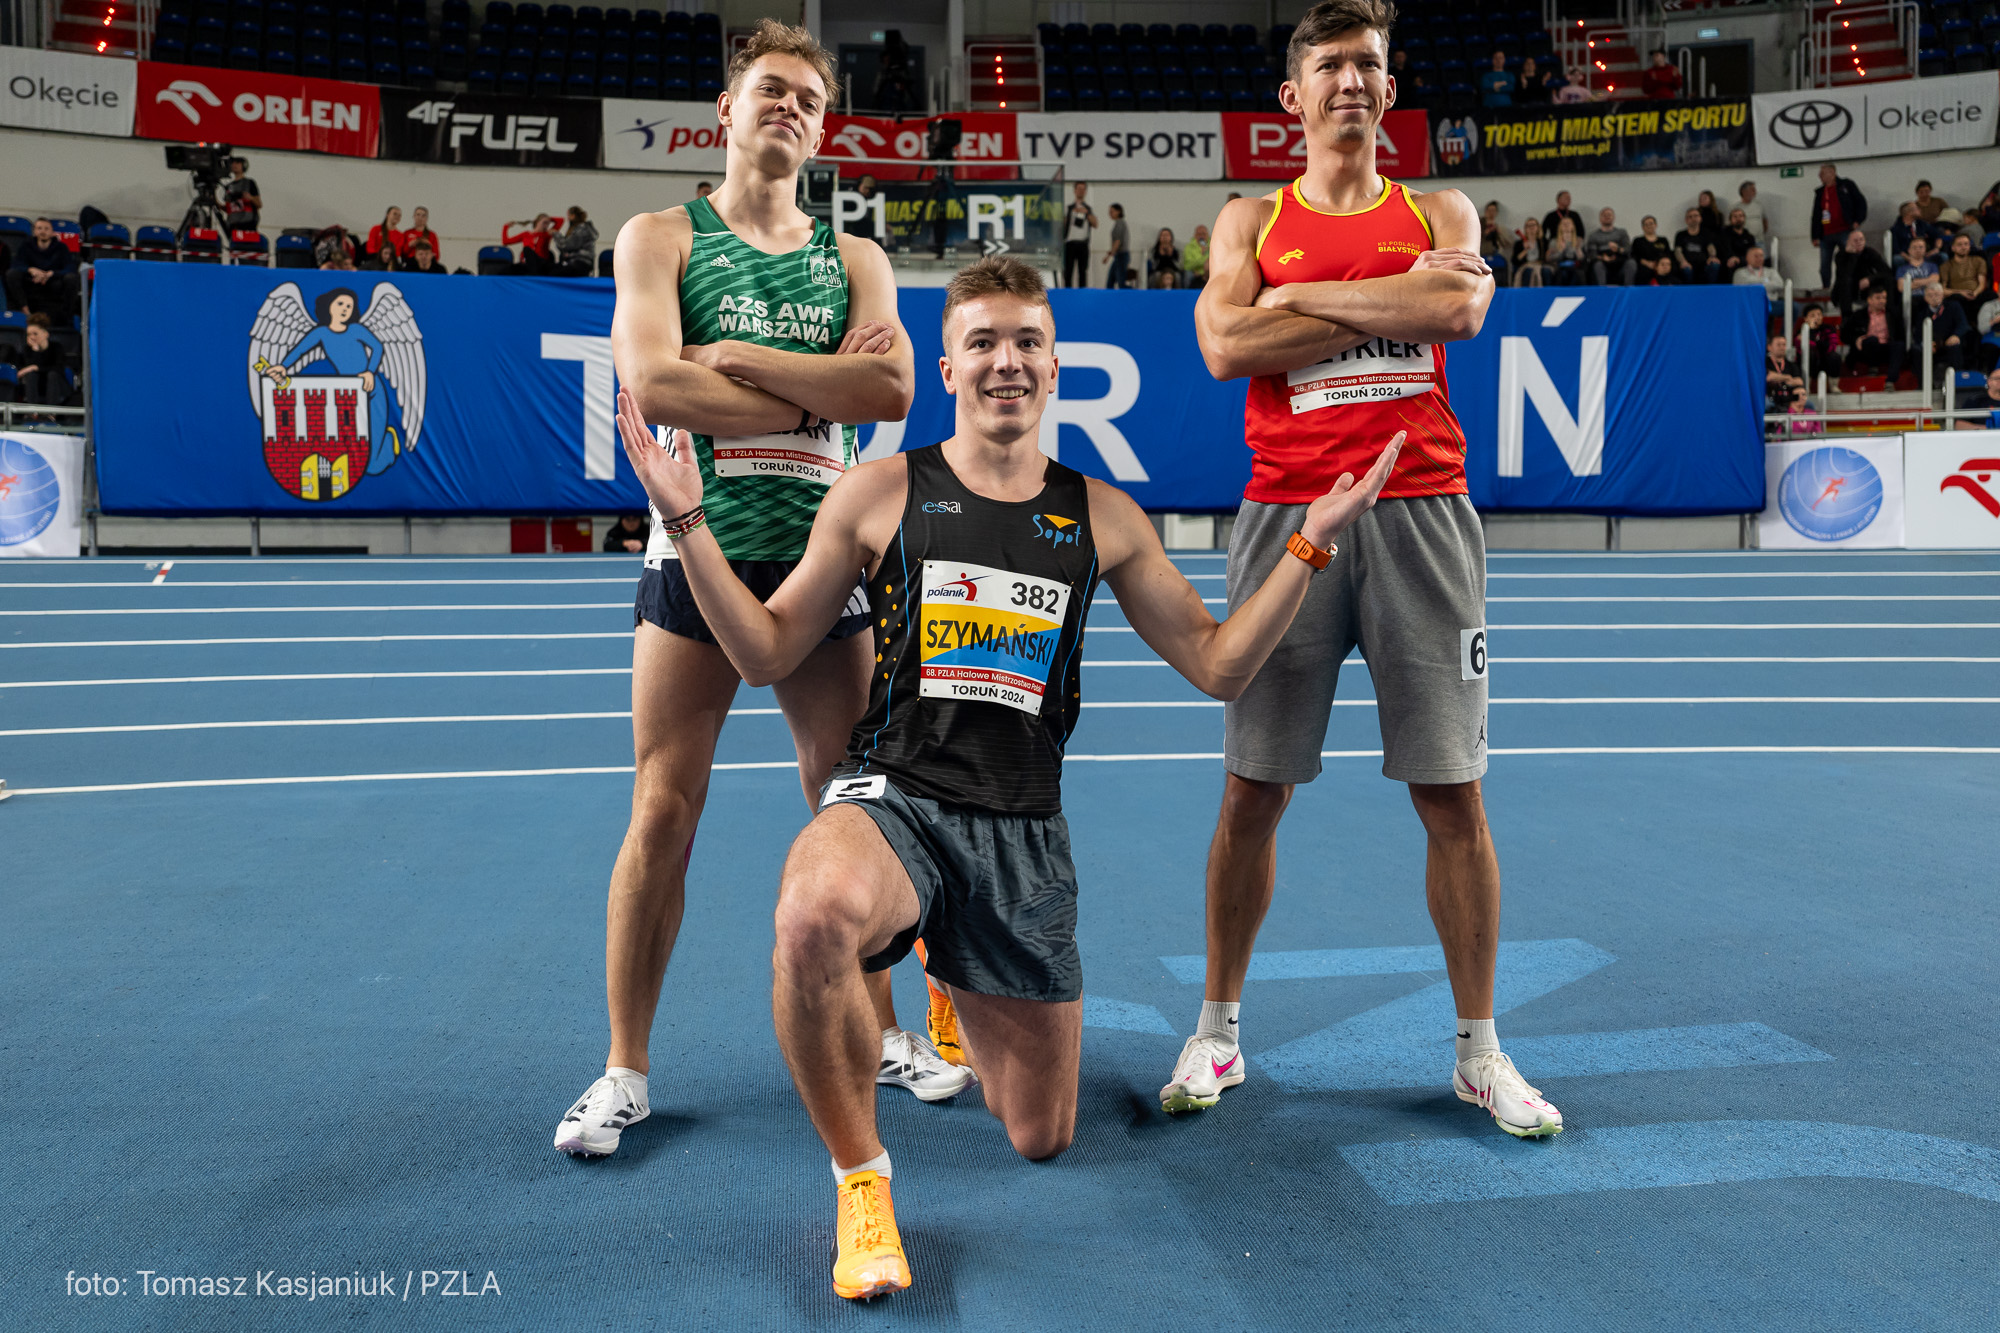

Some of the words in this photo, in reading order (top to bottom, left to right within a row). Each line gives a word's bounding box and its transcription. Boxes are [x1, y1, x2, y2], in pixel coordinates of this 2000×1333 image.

[10, 75, 119, 109] Okęcie
[233, 93, 361, 131] ORLEN
[407, 100, 455, 125] 4F
[450, 114, 578, 153] FUEL
[1560, 110, 1659, 142] MIASTEM
[1662, 102, 1747, 133] SPORTU
[1879, 100, 1982, 131] Okęcie
[894, 130, 1003, 158] OEN
[1024, 132, 1095, 158] TVP
[1104, 132, 1217, 159] SPORT
[1250, 122, 1399, 155] PZA
[832, 191, 886, 239] P1
[967, 194, 1025, 240] R1
[718, 294, 769, 318] AZS
[776, 303, 835, 325] AWF
[718, 313, 830, 345] WARSZAWA
[1315, 336, 1424, 365] KIER
[1308, 382, 1325, 390] PZLA
[1327, 378, 1357, 387] Halowe
[1359, 374, 1406, 383] Mistrzostwa
[1408, 373, 1430, 381] Polski
[1324, 386, 1368, 401] TORUŃ
[1371, 387, 1402, 397] 2024
[751, 461, 794, 473] TORUŃ
[796, 465, 822, 478] 2024
[786, 452, 826, 466] Mistrzostwa
[1032, 513, 1082, 549] Sopot
[926, 587, 966, 599] polanik
[1010, 582, 1060, 615] 382
[926, 619, 1054, 666] SZYMAŃSKI
[1470, 631, 1486, 675] 6
[926, 668, 937, 677] 68.
[938, 669, 955, 678] PZLA
[957, 670, 990, 680] Halowe
[991, 673, 1031, 690] Mistrzostwa
[952, 684, 998, 698] TORUŃ
[1001, 689, 1025, 704] 2024
